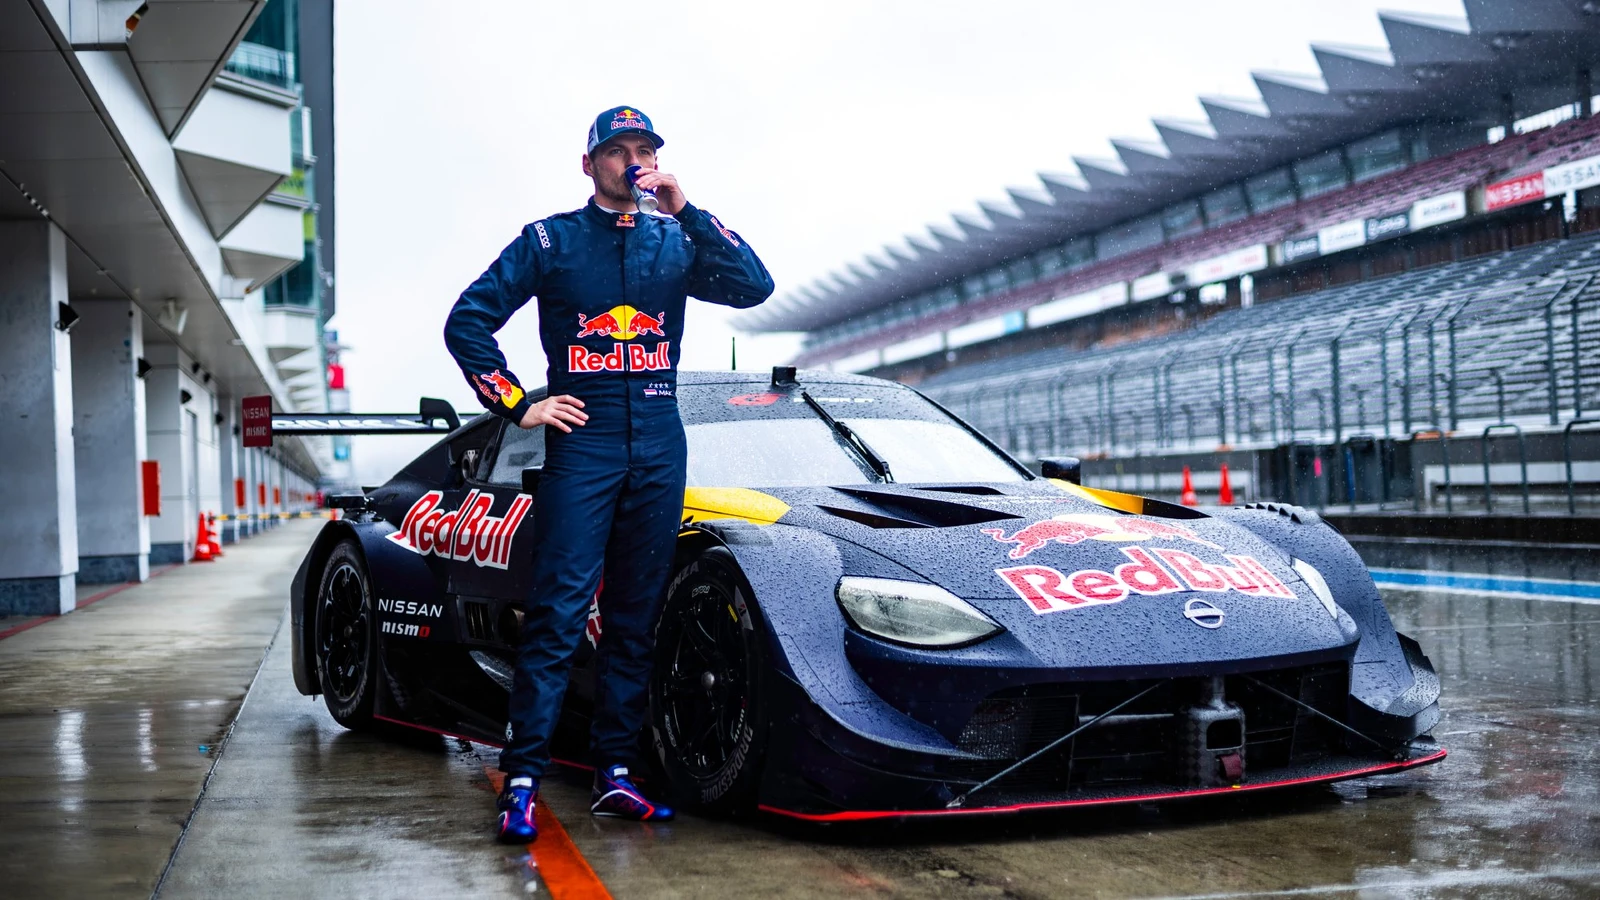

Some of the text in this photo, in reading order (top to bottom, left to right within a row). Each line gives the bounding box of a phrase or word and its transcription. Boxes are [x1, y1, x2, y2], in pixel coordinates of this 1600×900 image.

[1551, 163, 1600, 190] NISSA
[568, 341, 671, 373] Red Bull
[242, 407, 270, 420] NISSAN
[385, 489, 533, 570] Red Bull
[994, 546, 1298, 615] Red Bull
[378, 598, 443, 618] NISSAN
